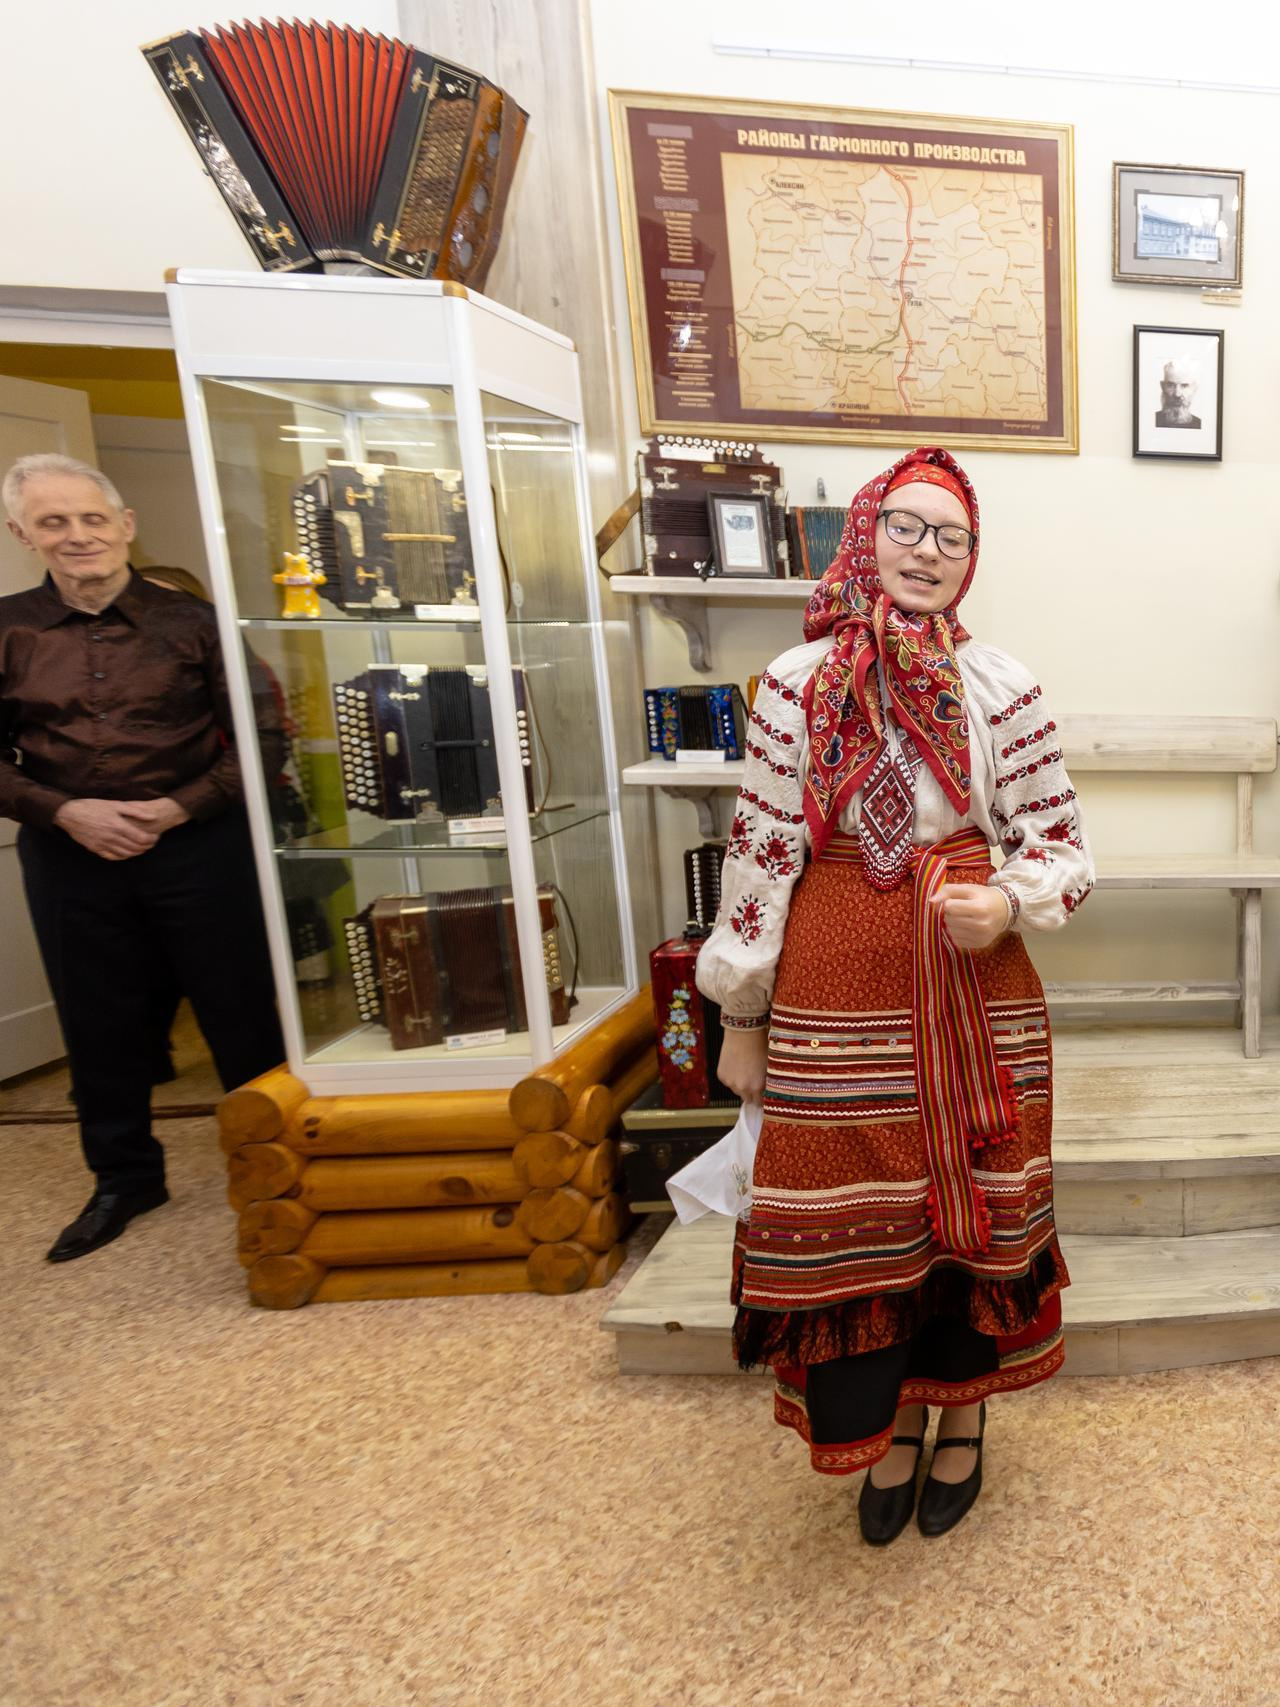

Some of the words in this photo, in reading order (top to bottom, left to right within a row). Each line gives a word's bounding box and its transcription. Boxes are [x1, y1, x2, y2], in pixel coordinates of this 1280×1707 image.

[737, 129, 806, 150] РАЙОНЫ
[810, 134, 909, 157] ГАРМОННОГО
[914, 142, 1027, 166] ПРОИЗВОДСТВА
[775, 181, 805, 190] АЛЕКСИН
